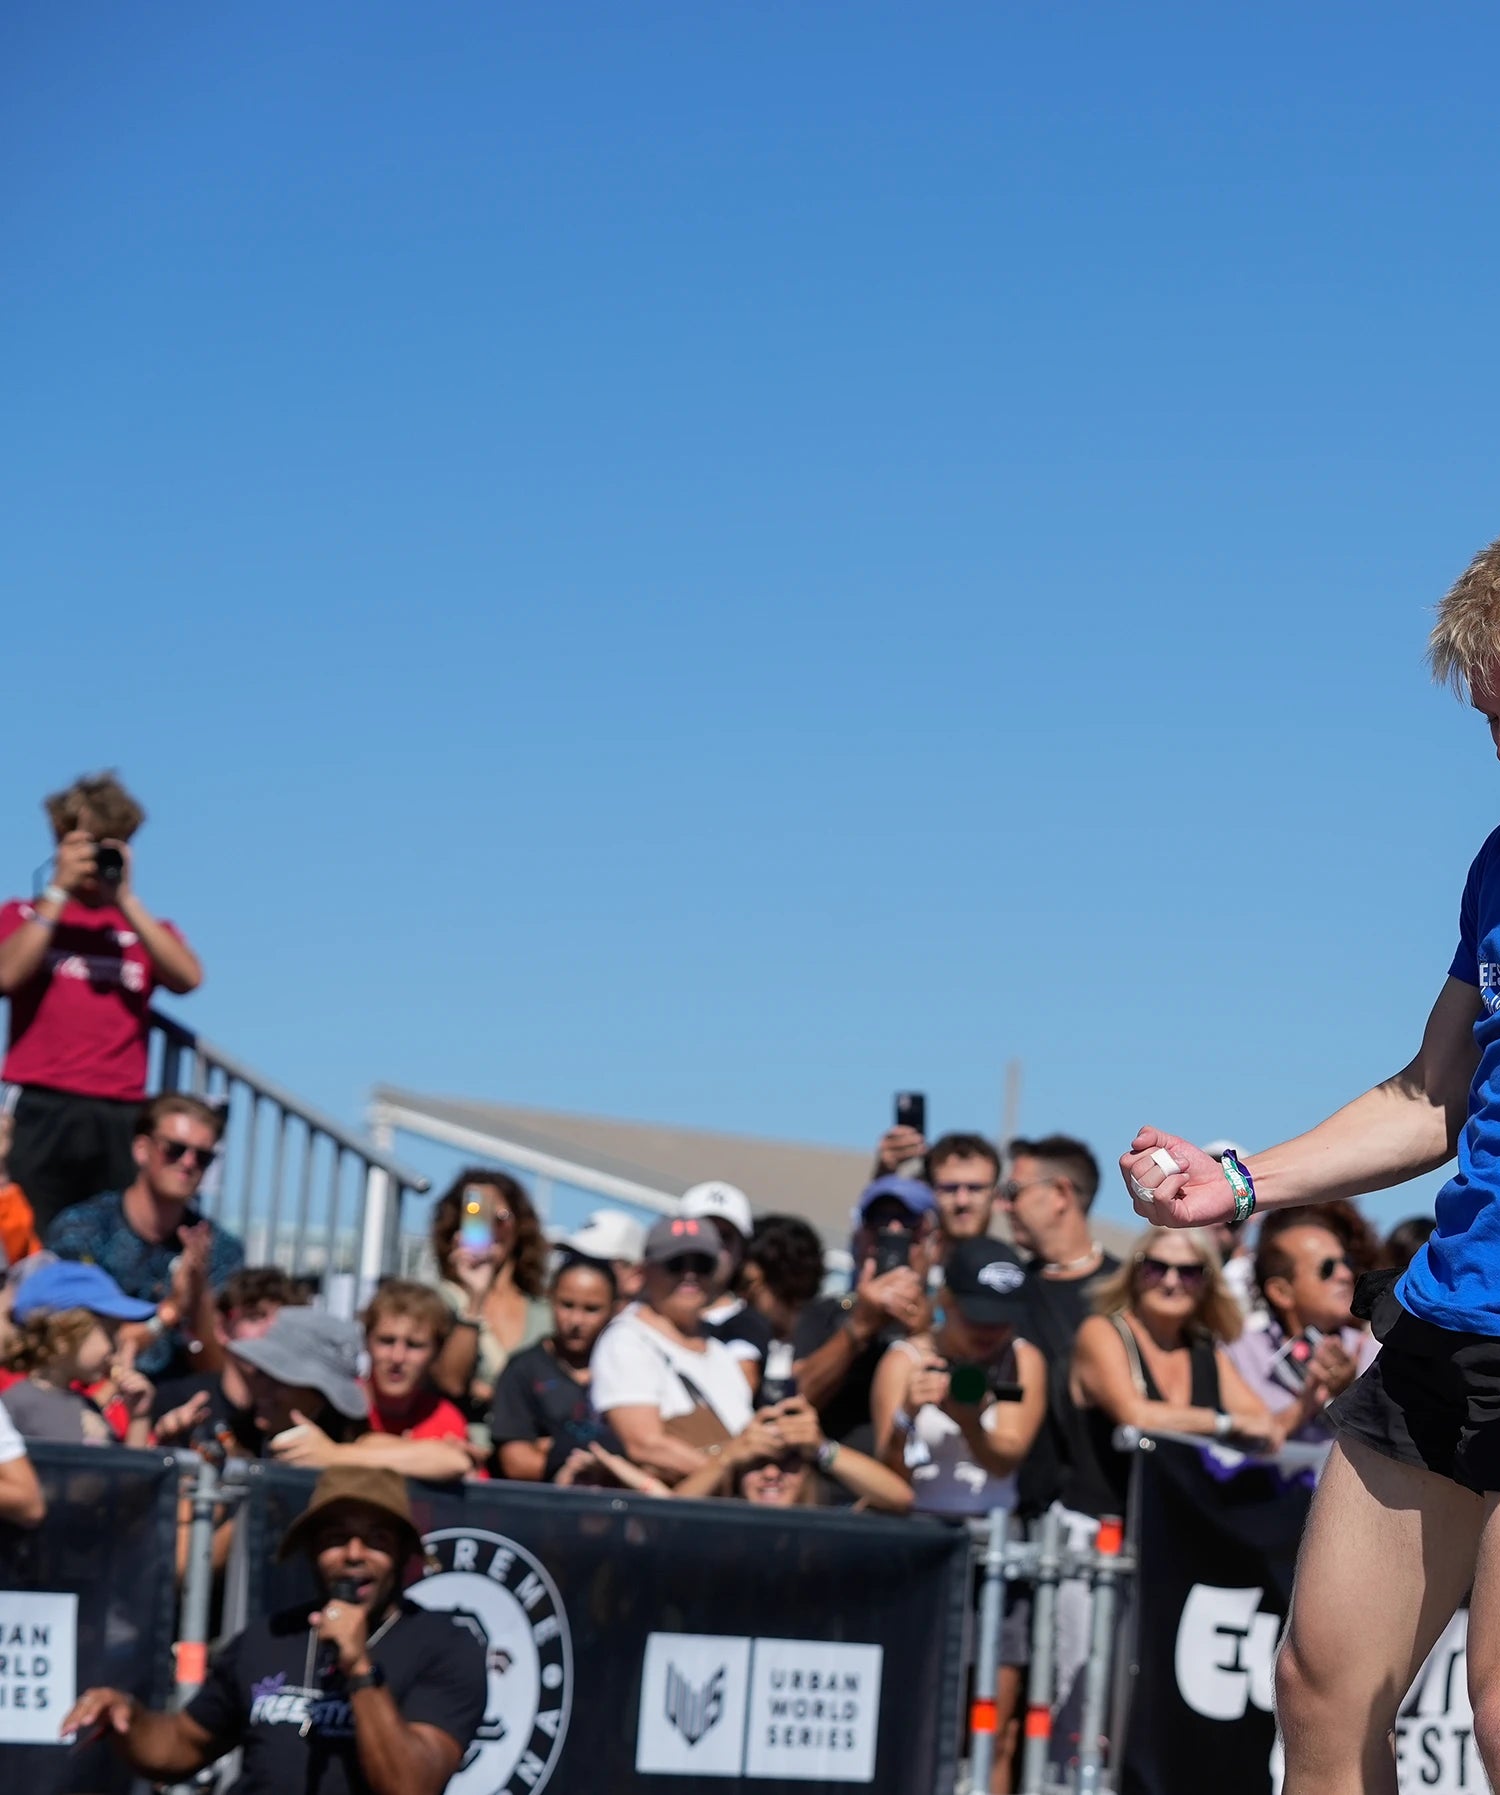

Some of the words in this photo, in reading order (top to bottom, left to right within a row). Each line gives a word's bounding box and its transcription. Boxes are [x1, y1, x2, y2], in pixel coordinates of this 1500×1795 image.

[0, 1624, 50, 1645] AN
[770, 1668, 860, 1690] URBAN
[768, 1697, 858, 1721] WORLD
[767, 1724, 856, 1750] SERIES
